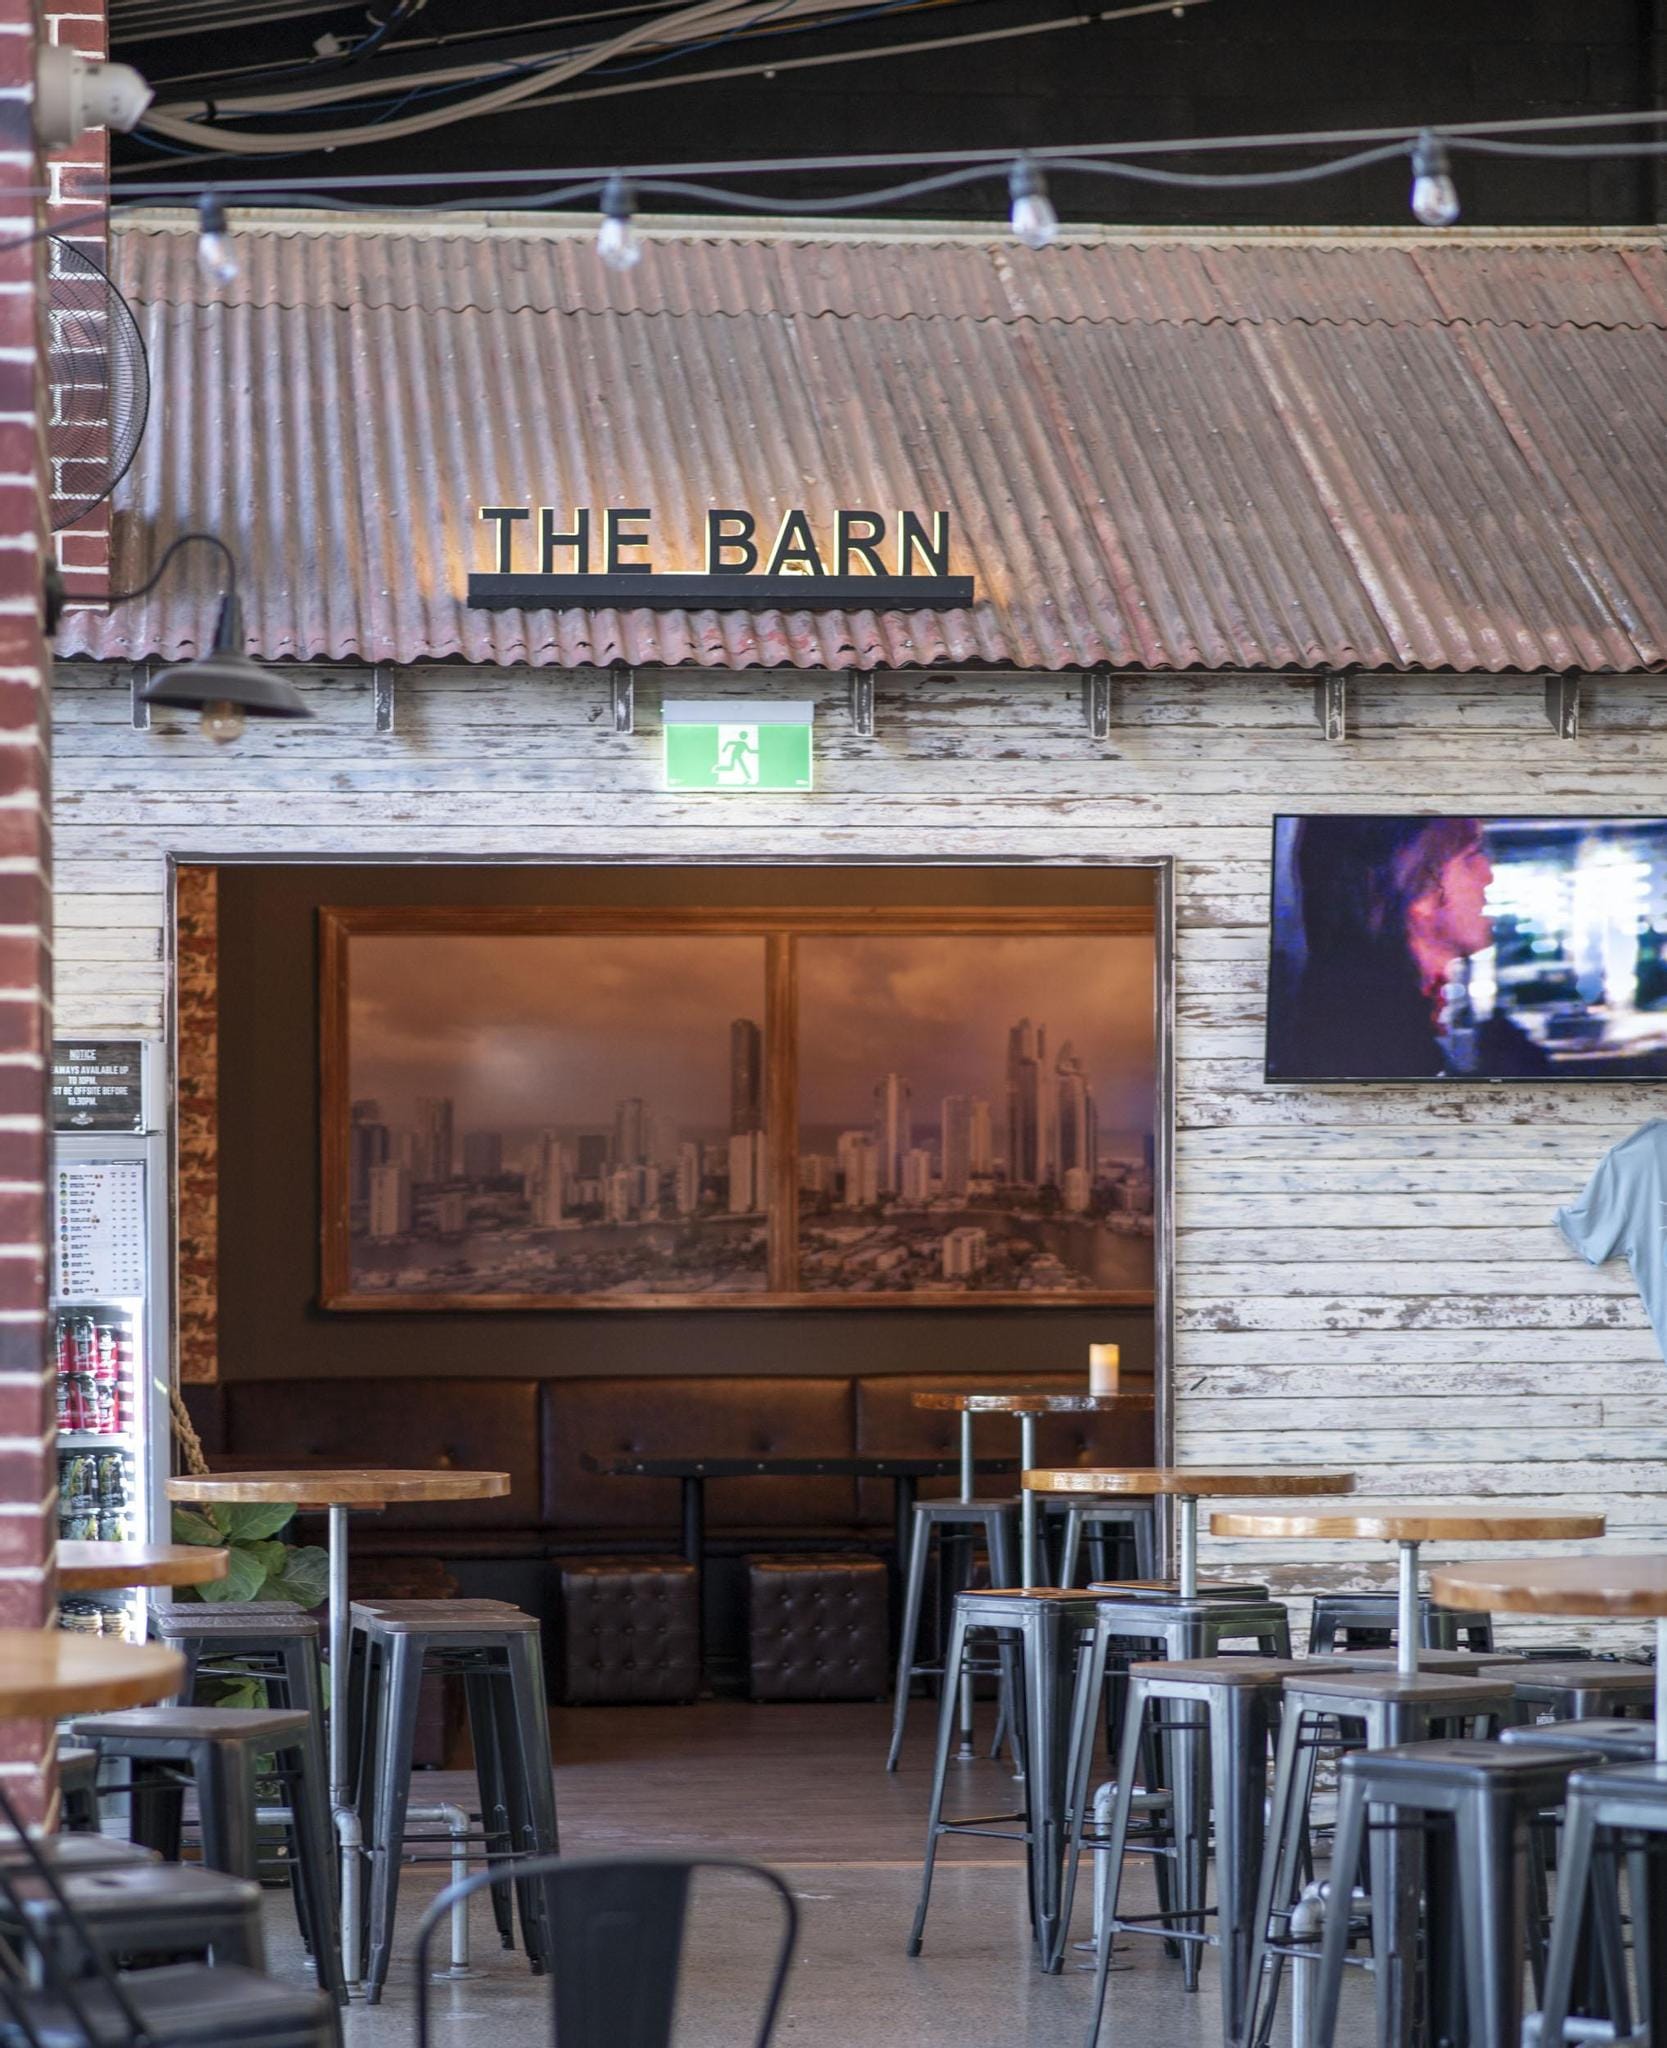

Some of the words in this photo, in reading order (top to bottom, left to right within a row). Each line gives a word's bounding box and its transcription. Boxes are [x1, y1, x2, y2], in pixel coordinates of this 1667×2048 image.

[480, 507, 652, 574] THE
[705, 508, 950, 576] BARN
[80, 1066, 118, 1074] AVAILABLE
[68, 1076, 77, 1085] TO
[63, 1087, 73, 1095] BE
[74, 1087, 101, 1095] OFFSITE
[102, 1087, 128, 1095] BEFORE
